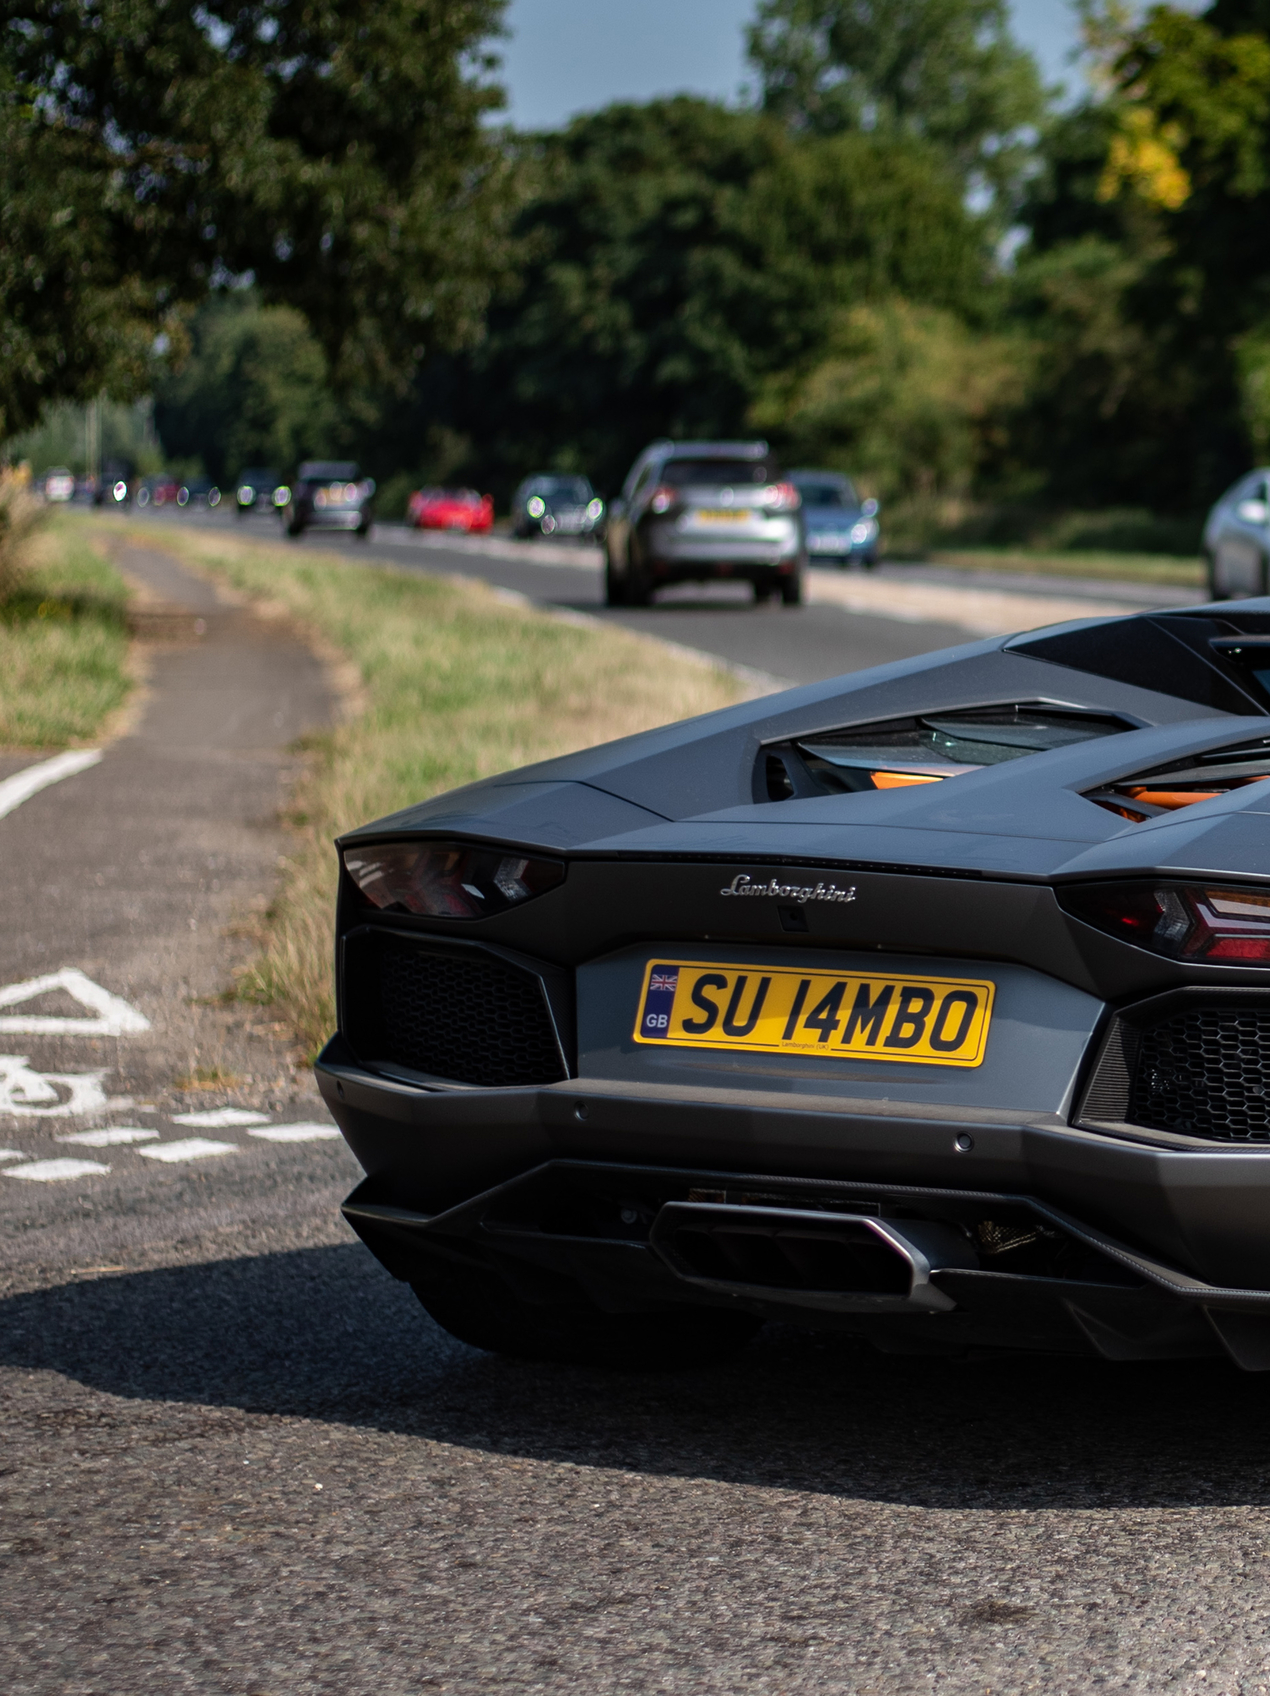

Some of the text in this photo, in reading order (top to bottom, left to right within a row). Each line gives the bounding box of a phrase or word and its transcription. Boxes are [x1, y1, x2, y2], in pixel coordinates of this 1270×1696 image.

[720, 874, 856, 903] Lamborghini
[682, 973, 772, 1038] SU
[646, 1013, 668, 1028] GB
[781, 1041, 829, 1051] Lamborghini (UK)
